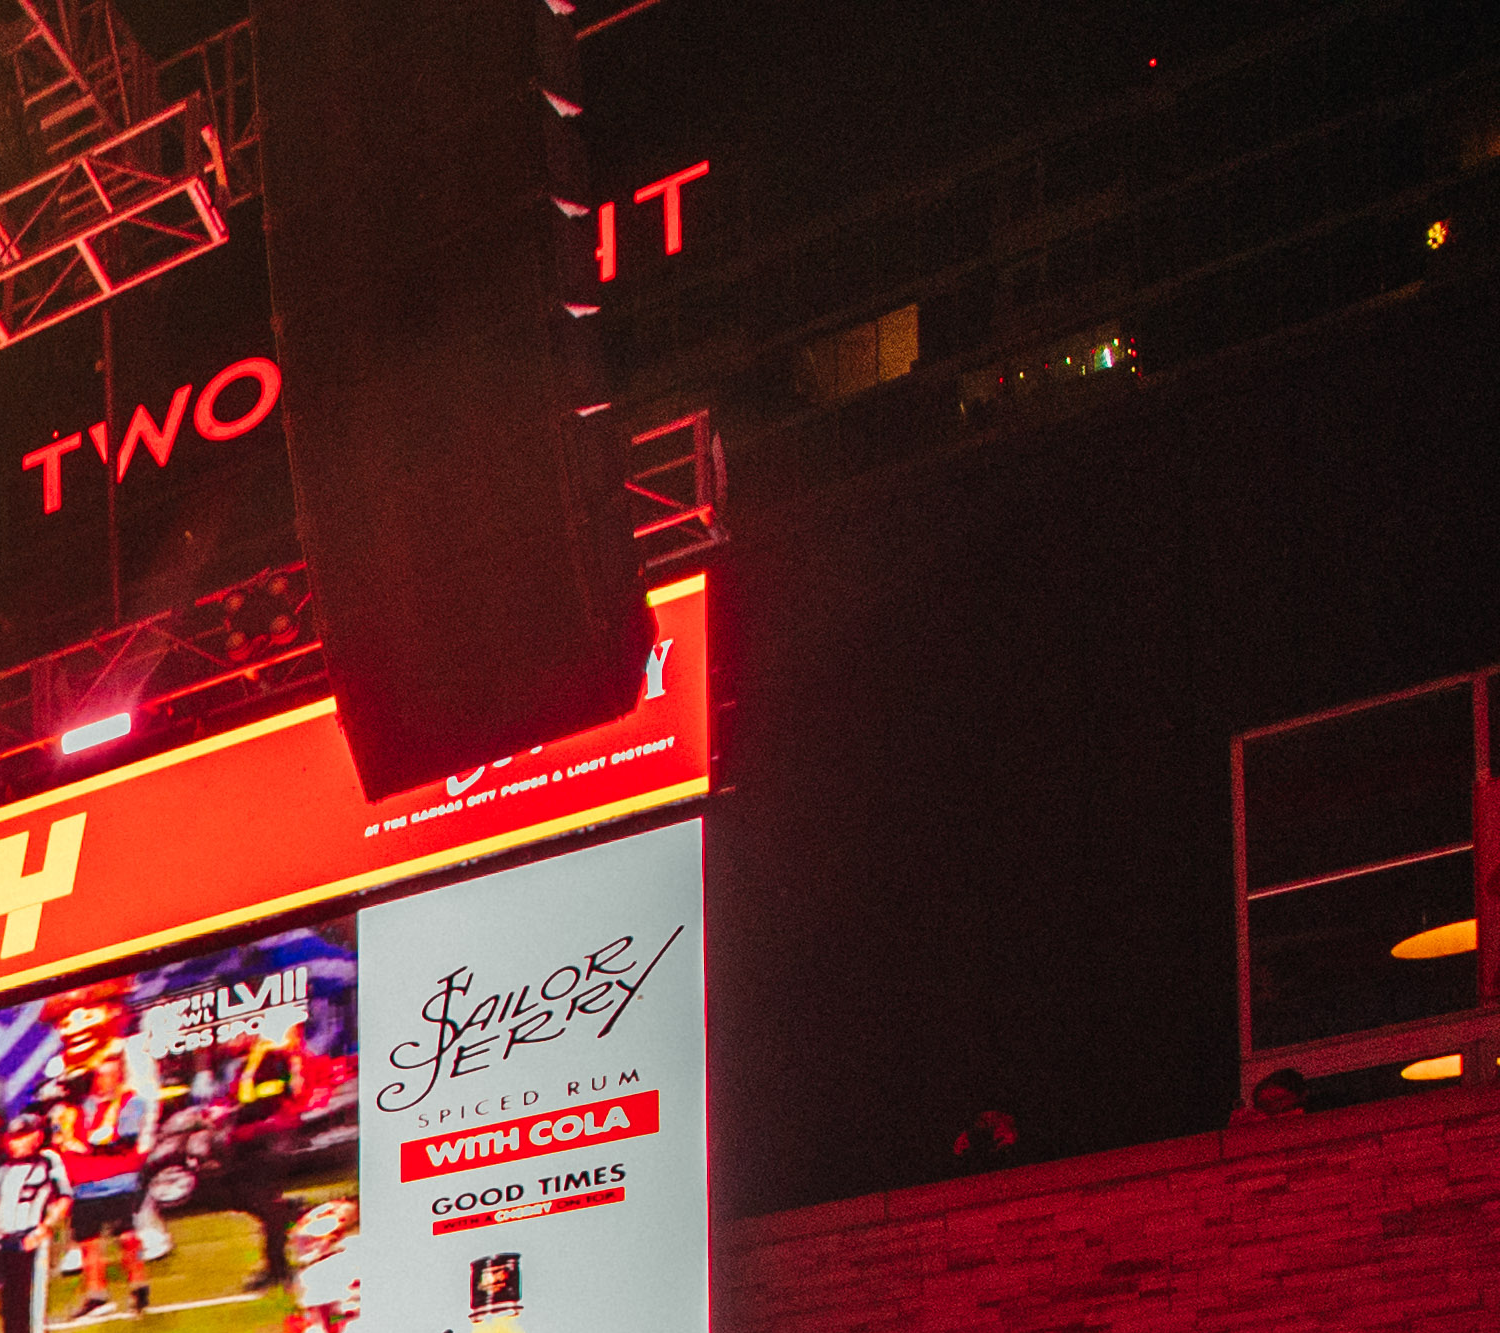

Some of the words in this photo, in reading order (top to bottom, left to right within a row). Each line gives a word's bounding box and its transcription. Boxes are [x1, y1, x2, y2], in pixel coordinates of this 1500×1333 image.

[22, 356, 282, 514] TWO
[217, 966, 308, 1020] LVIII
[417, 1091, 540, 1129] SPICED
[566, 1069, 641, 1097] RUM
[425, 1126, 520, 1168] WITH
[528, 1105, 631, 1147] COLA
[431, 1183, 525, 1216] GOOD
[537, 1162, 627, 1196] TIMES
